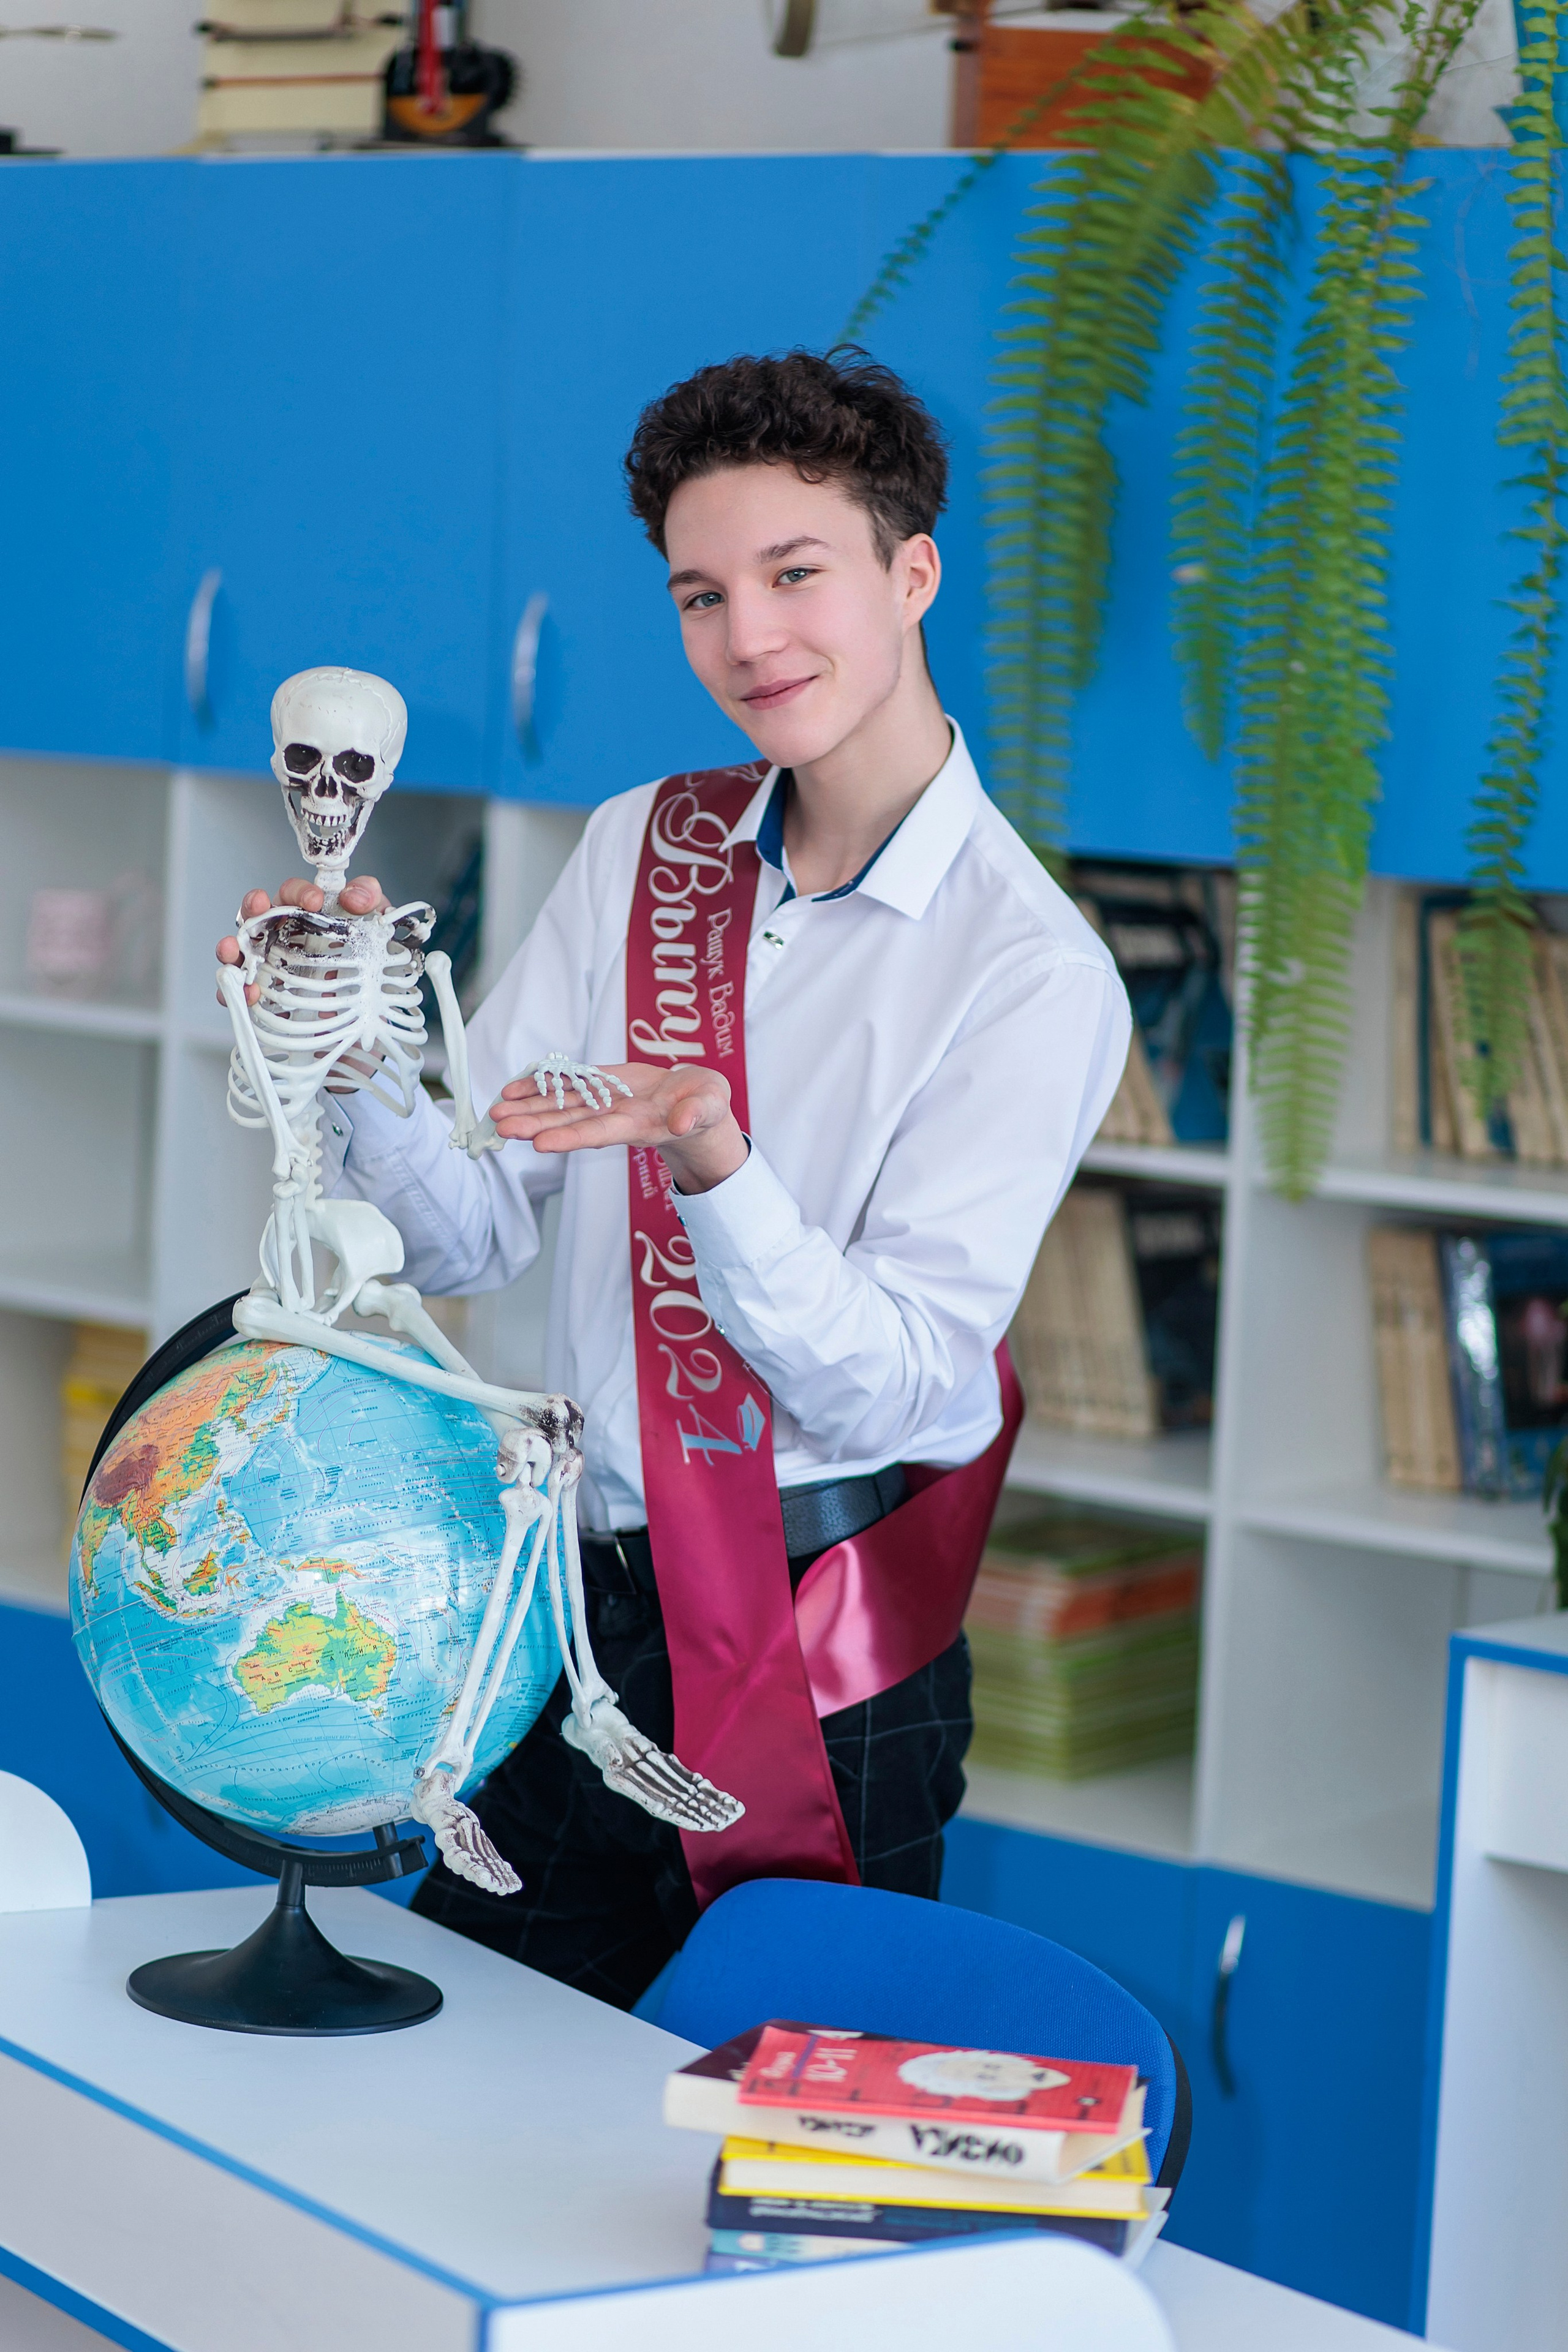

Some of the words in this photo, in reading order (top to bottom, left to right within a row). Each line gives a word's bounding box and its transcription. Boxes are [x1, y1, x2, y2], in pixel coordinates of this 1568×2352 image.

[629, 792, 734, 1072] Выпу
[699, 907, 733, 981] Ращук
[708, 981, 736, 1058] Вадим
[634, 1230, 742, 1465] 2024
